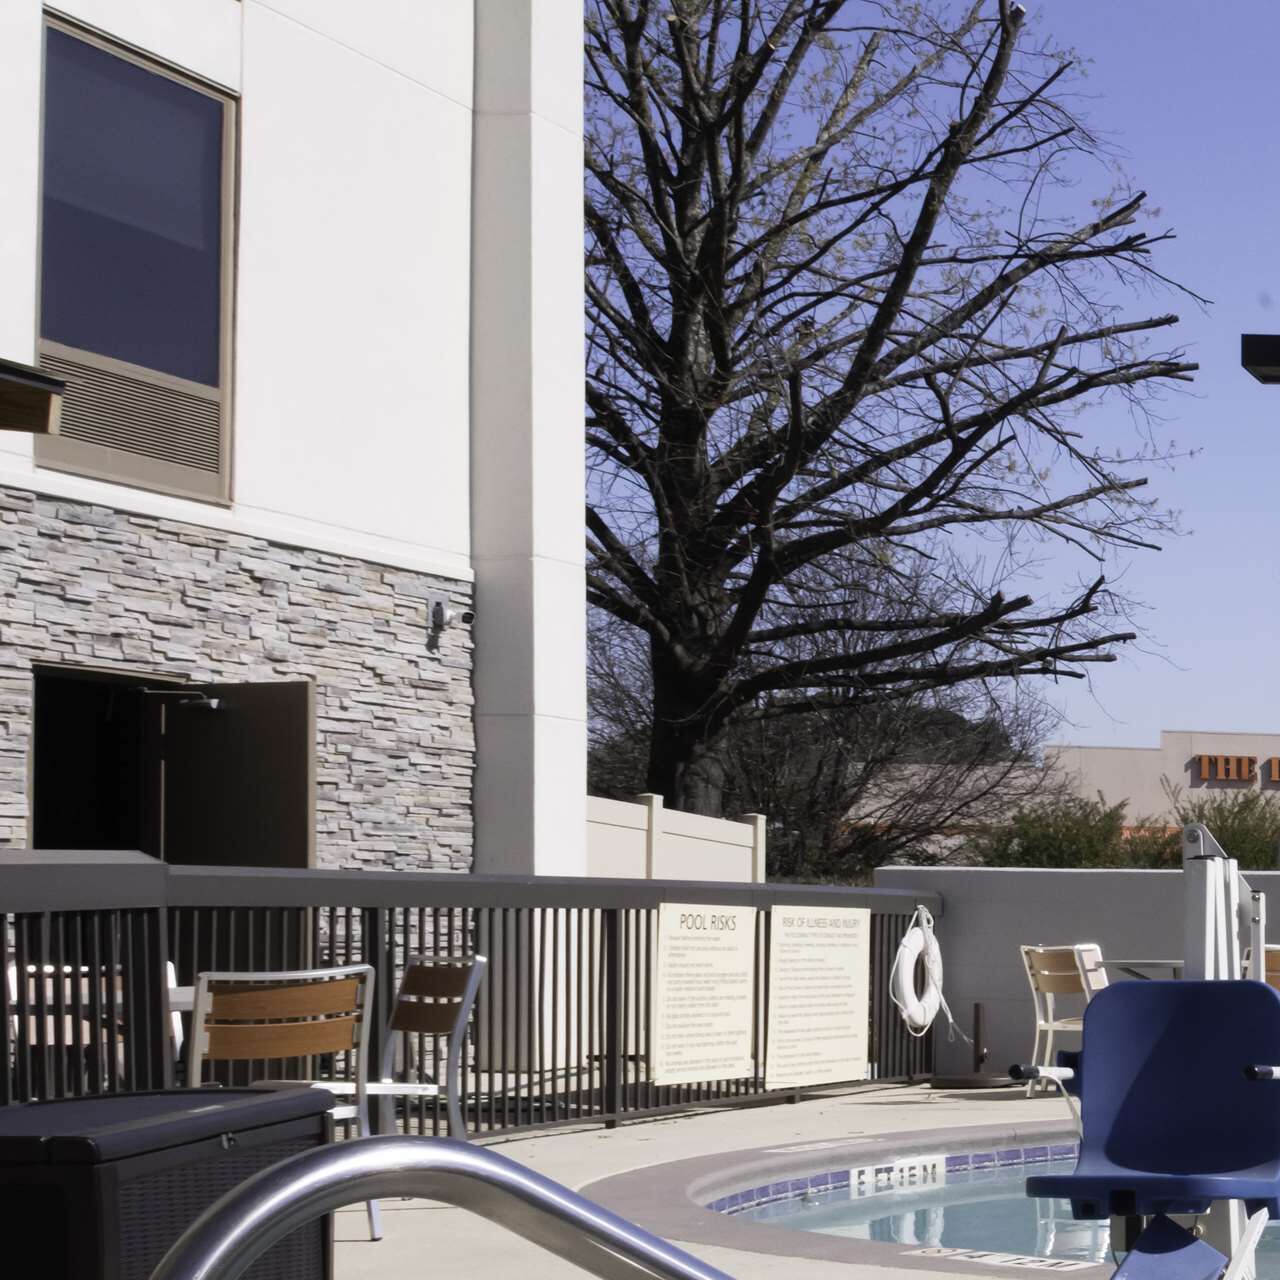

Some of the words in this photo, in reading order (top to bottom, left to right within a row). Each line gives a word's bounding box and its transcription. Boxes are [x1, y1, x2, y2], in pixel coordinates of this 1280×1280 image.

[1195, 754, 1257, 782] THE
[680, 914, 707, 930] POOL
[710, 914, 736, 931] RISKS
